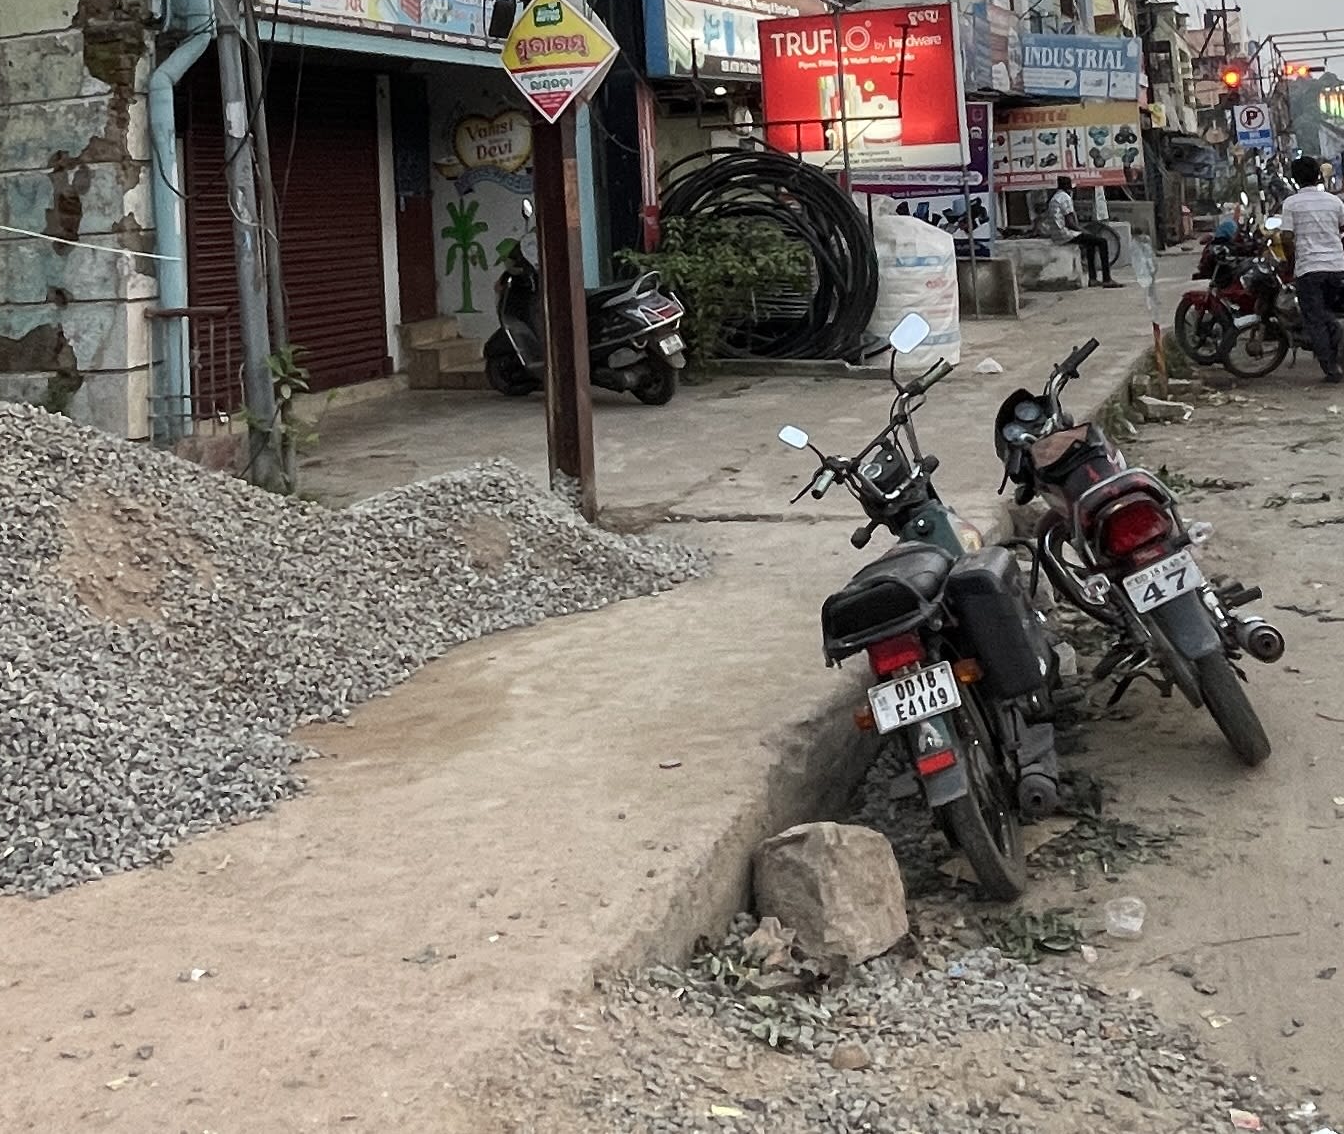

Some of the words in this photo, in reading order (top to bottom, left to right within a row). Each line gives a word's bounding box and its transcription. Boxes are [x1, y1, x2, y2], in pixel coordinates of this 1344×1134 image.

[874, 40, 886, 51] by
[1024, 46, 1126, 70] INDUSTRIAL
[476, 139, 513, 160] Devi
[896, 687, 948, 721] E4149
